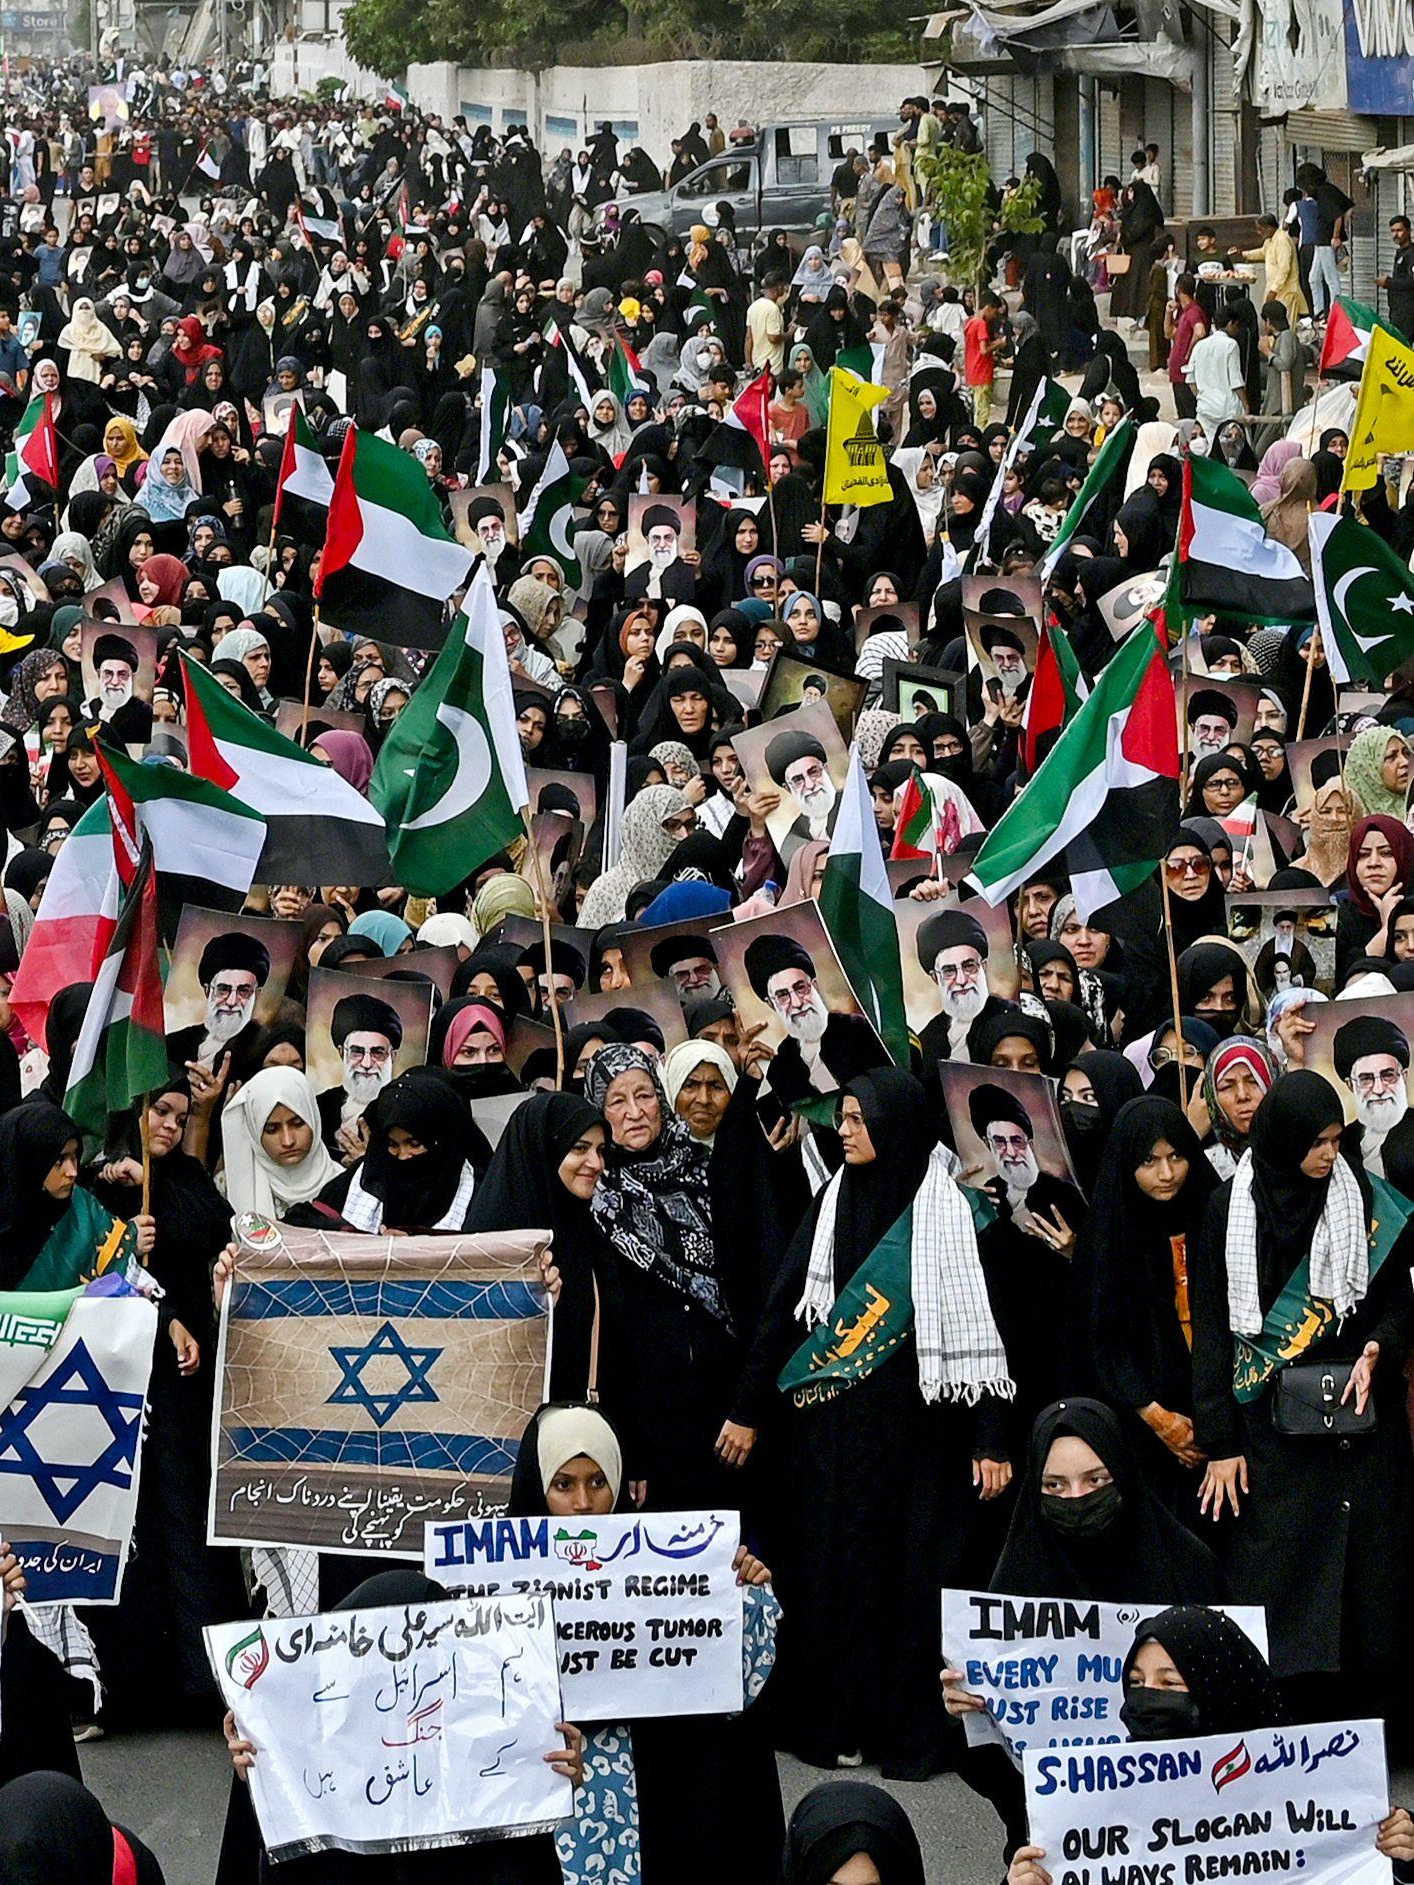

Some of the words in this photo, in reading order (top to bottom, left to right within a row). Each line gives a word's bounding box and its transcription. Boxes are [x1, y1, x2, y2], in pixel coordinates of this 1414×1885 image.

[22, 14, 57, 27] Store
[230, 1479, 273, 1512] انجام
[406, 1482, 467, 1515] حکومت
[433, 1518, 549, 1567] IMAM
[59, 1553, 102, 1574] ایران
[645, 1618, 724, 1641] TUMOR
[968, 1596, 1101, 1641] IMAM
[610, 1649, 638, 1671] BE
[649, 1647, 698, 1668] CUT
[966, 1654, 1059, 1689] EVERY
[381, 1698, 444, 1747] جنگ
[365, 1754, 434, 1805] عاشق
[1035, 1750, 1202, 1795] S.HASSAN
[1062, 1825, 1129, 1861] OUR
[1147, 1810, 1272, 1851] SLOGAN
